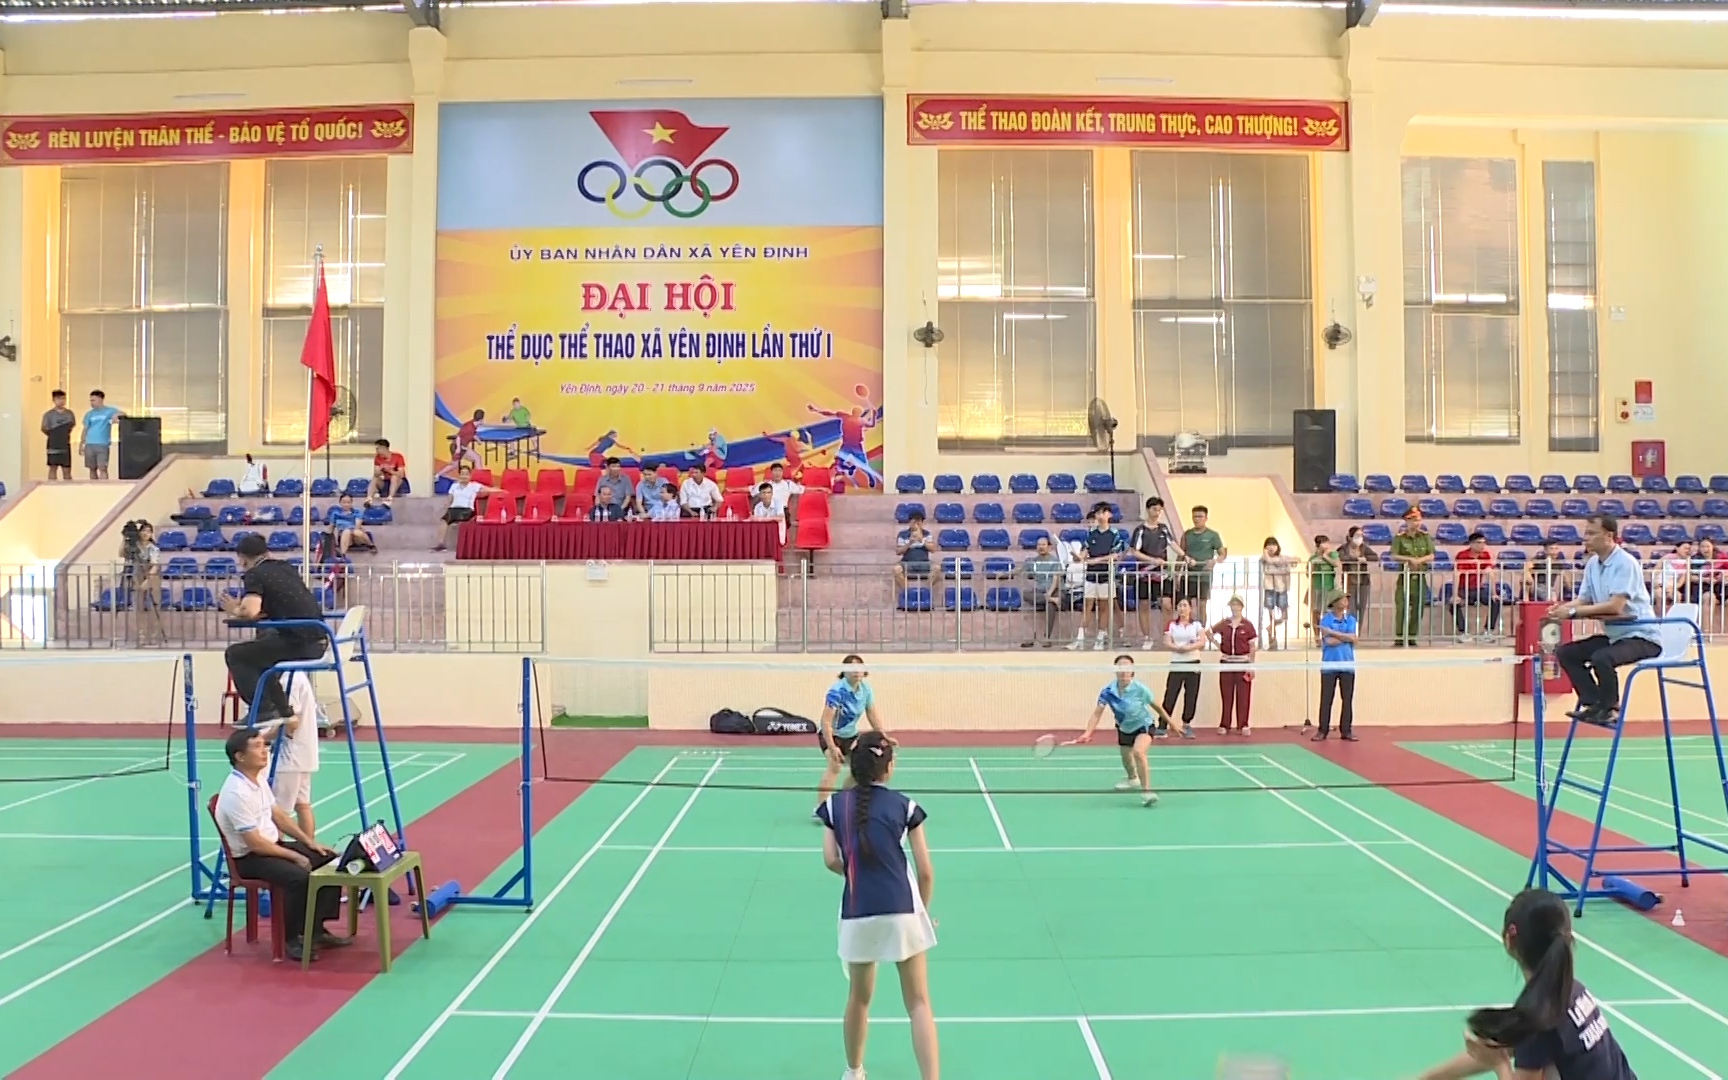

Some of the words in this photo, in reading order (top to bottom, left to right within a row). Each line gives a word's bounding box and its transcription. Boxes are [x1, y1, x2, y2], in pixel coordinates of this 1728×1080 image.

[48, 127, 81, 148] RÈN
[84, 126, 135, 152] LUYỆN
[138, 125, 181, 146] THÂN
[184, 119, 216, 145] THỂ
[229, 119, 262, 144] BẢO
[265, 121, 286, 146] VỆ
[289, 117, 311, 141] TỔ
[314, 115, 364, 142] QUỐC!
[959, 103, 988, 131] THỂ
[990, 111, 1028, 131] THAO
[1031, 107, 1072, 132] ĐOÀN
[1075, 105, 1105, 134] KẾT,
[1107, 112, 1156, 133] TRUNG
[1159, 111, 1201, 138] THỰC,
[1204, 114, 1233, 135] CAO
[1236, 113, 1298, 140] THƯỢNG!
[510, 243, 533, 260] ỦY
[540, 248, 578, 260] BAN
[584, 244, 636, 260] NHÂN
[643, 243, 681, 259] DÂN
[688, 243, 712, 258] XÃ
[719, 243, 756, 258] YÊN
[763, 246, 808, 261] ĐỊNH
[581, 282, 652, 319] ĐẠI
[663, 273, 737, 318] HỘI
[486, 323, 516, 360] THỂ
[520, 333, 553, 366] DỤC
[558, 322, 589, 360] THỂ
[593, 333, 635, 360] THAO
[640, 327, 663, 359] XÃ
[668, 327, 700, 358] YÊN
[705, 332, 746, 364] ĐỊNH
[751, 323, 784, 358] LẦN
[789, 327, 823, 358] THỨ
[826, 332, 832, 358] I
[560, 383, 578, 394] Yên
[579, 383, 602, 395] Định,
[605, 383, 630, 395] ngày
[631, 383, 645, 394] 20
[652, 383, 665, 393] 21
[667, 383, 696, 395] tháng
[698, 383, 705, 392] 9
[706, 383, 727, 392] năm
[729, 383, 756, 393] 2025
